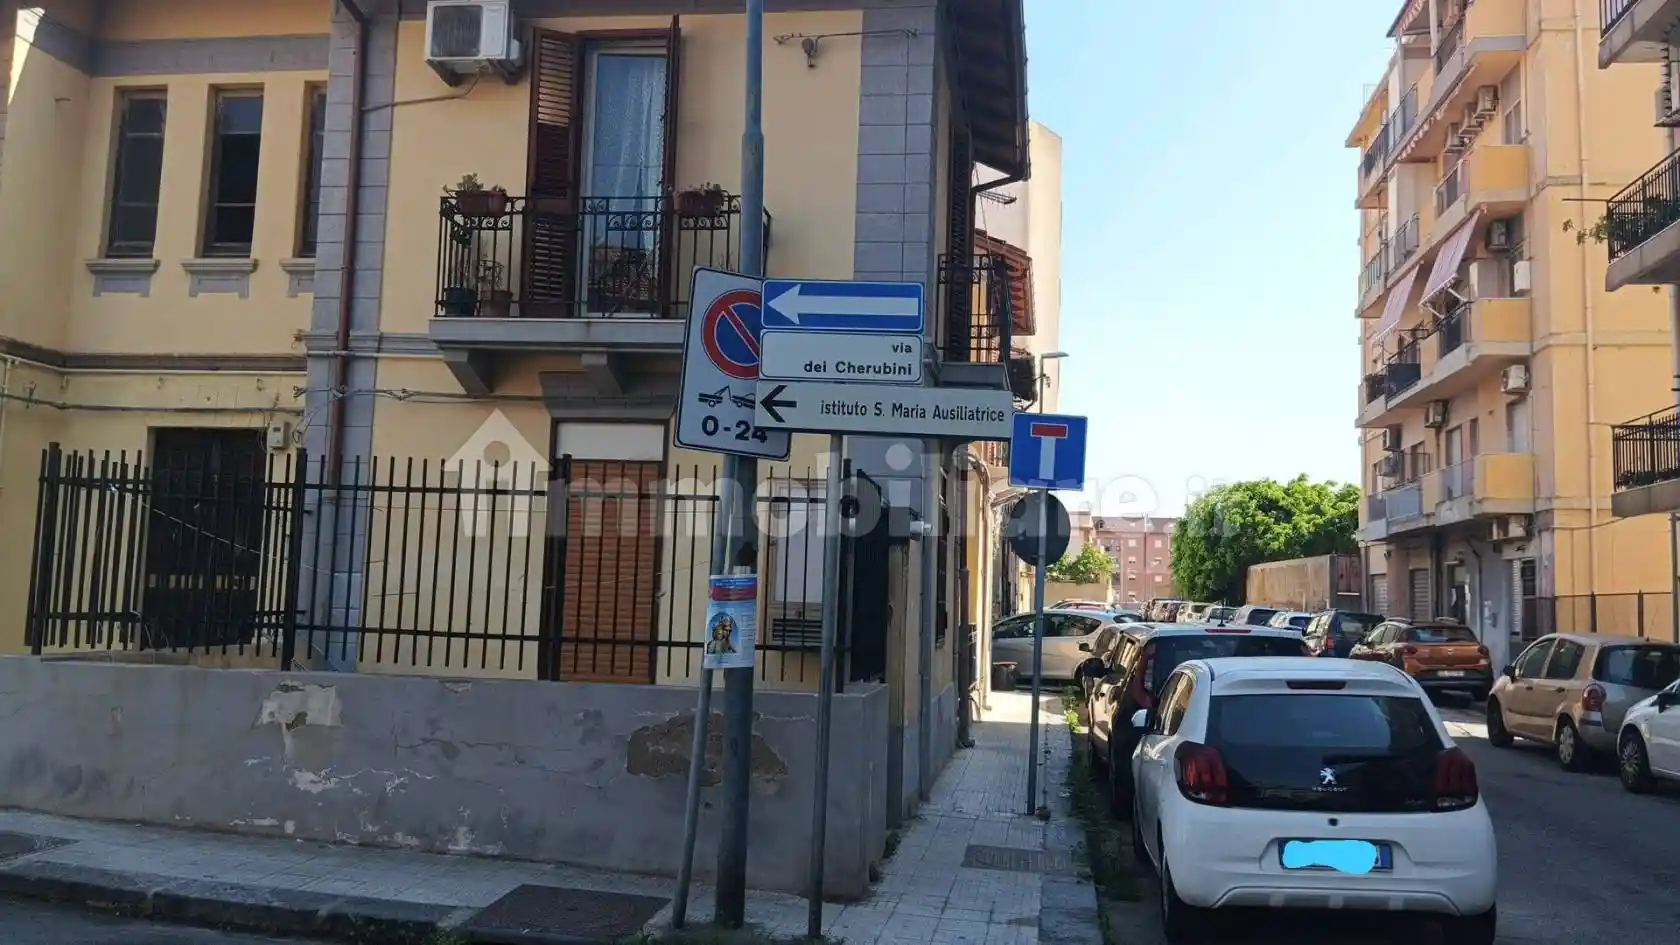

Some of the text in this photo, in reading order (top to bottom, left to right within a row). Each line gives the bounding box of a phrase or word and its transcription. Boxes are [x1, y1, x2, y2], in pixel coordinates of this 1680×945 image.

[891, 342, 912, 353] via
[803, 360, 912, 375] dei Cherubini
[820, 400, 1005, 422] istituto S. Maria Ausiliatrice
